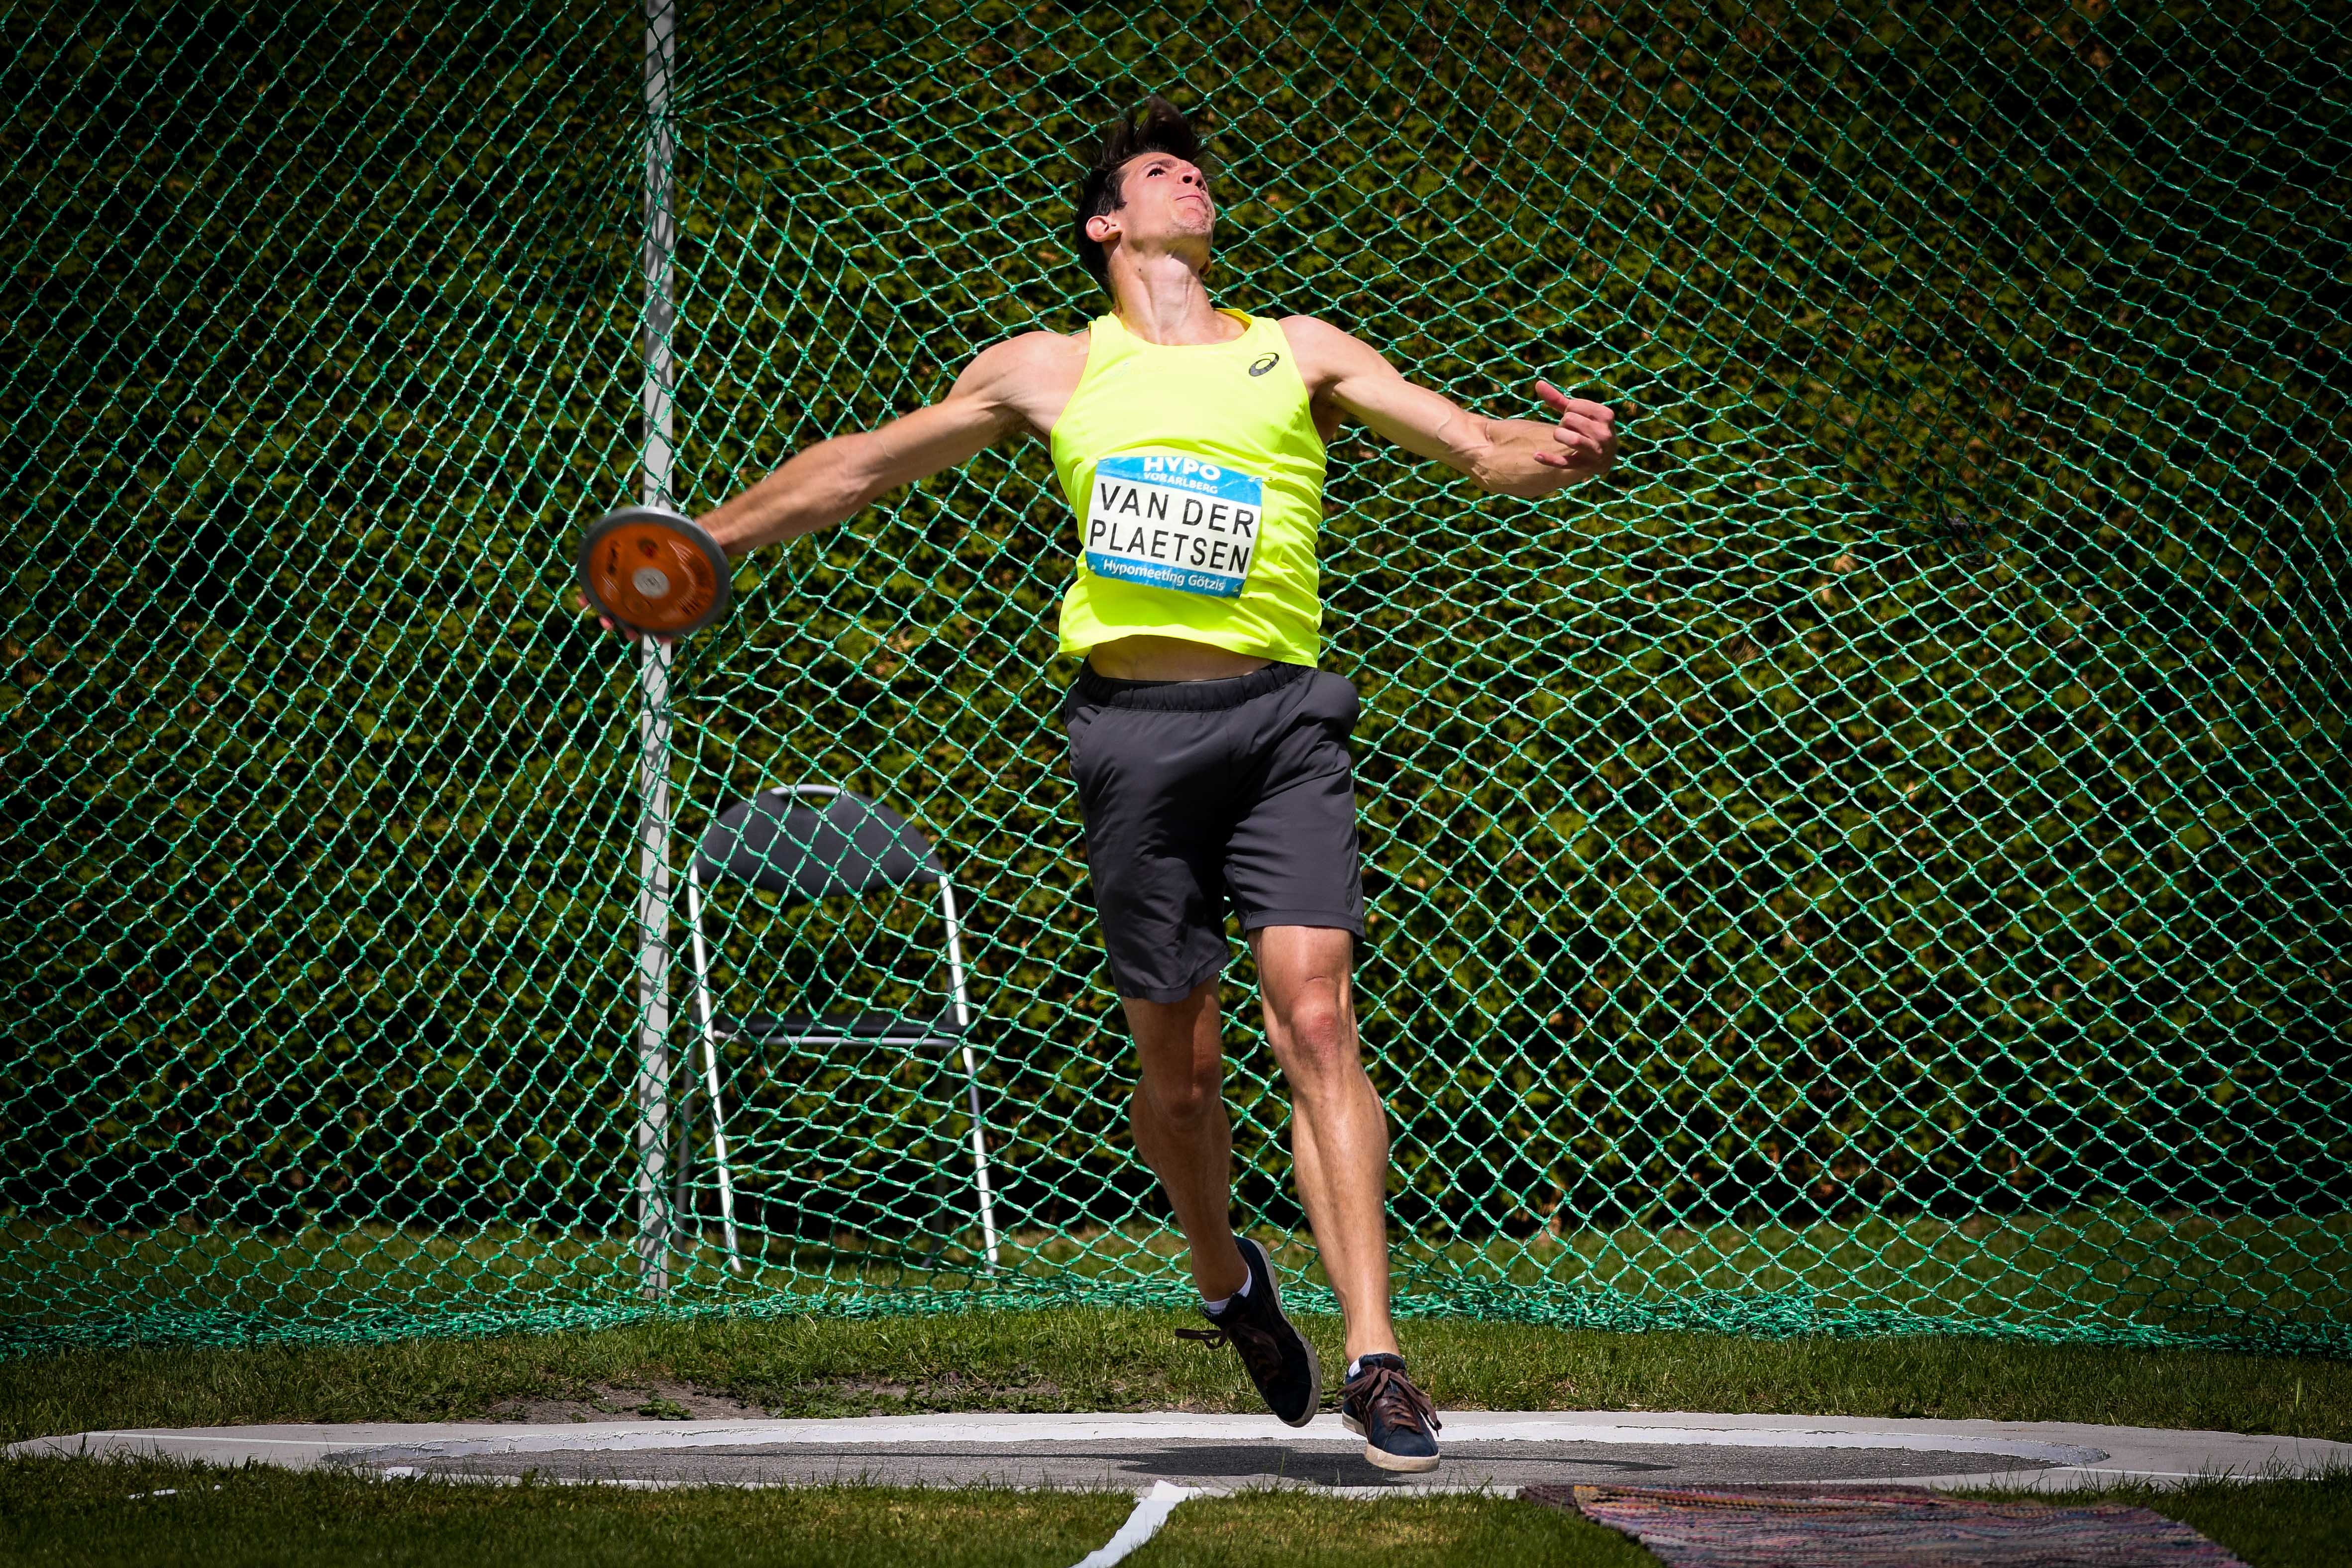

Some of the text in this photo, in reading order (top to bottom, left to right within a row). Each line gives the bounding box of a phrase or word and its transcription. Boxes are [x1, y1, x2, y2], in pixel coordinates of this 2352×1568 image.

[1144, 456, 1221, 481] HYPO
[1144, 472, 1218, 494] VORARLBERG
[1101, 483, 1254, 538] VAN DER
[1089, 519, 1250, 574] PLAETSEN
[1103, 558, 1226, 591] Hypomeeting Götzis
